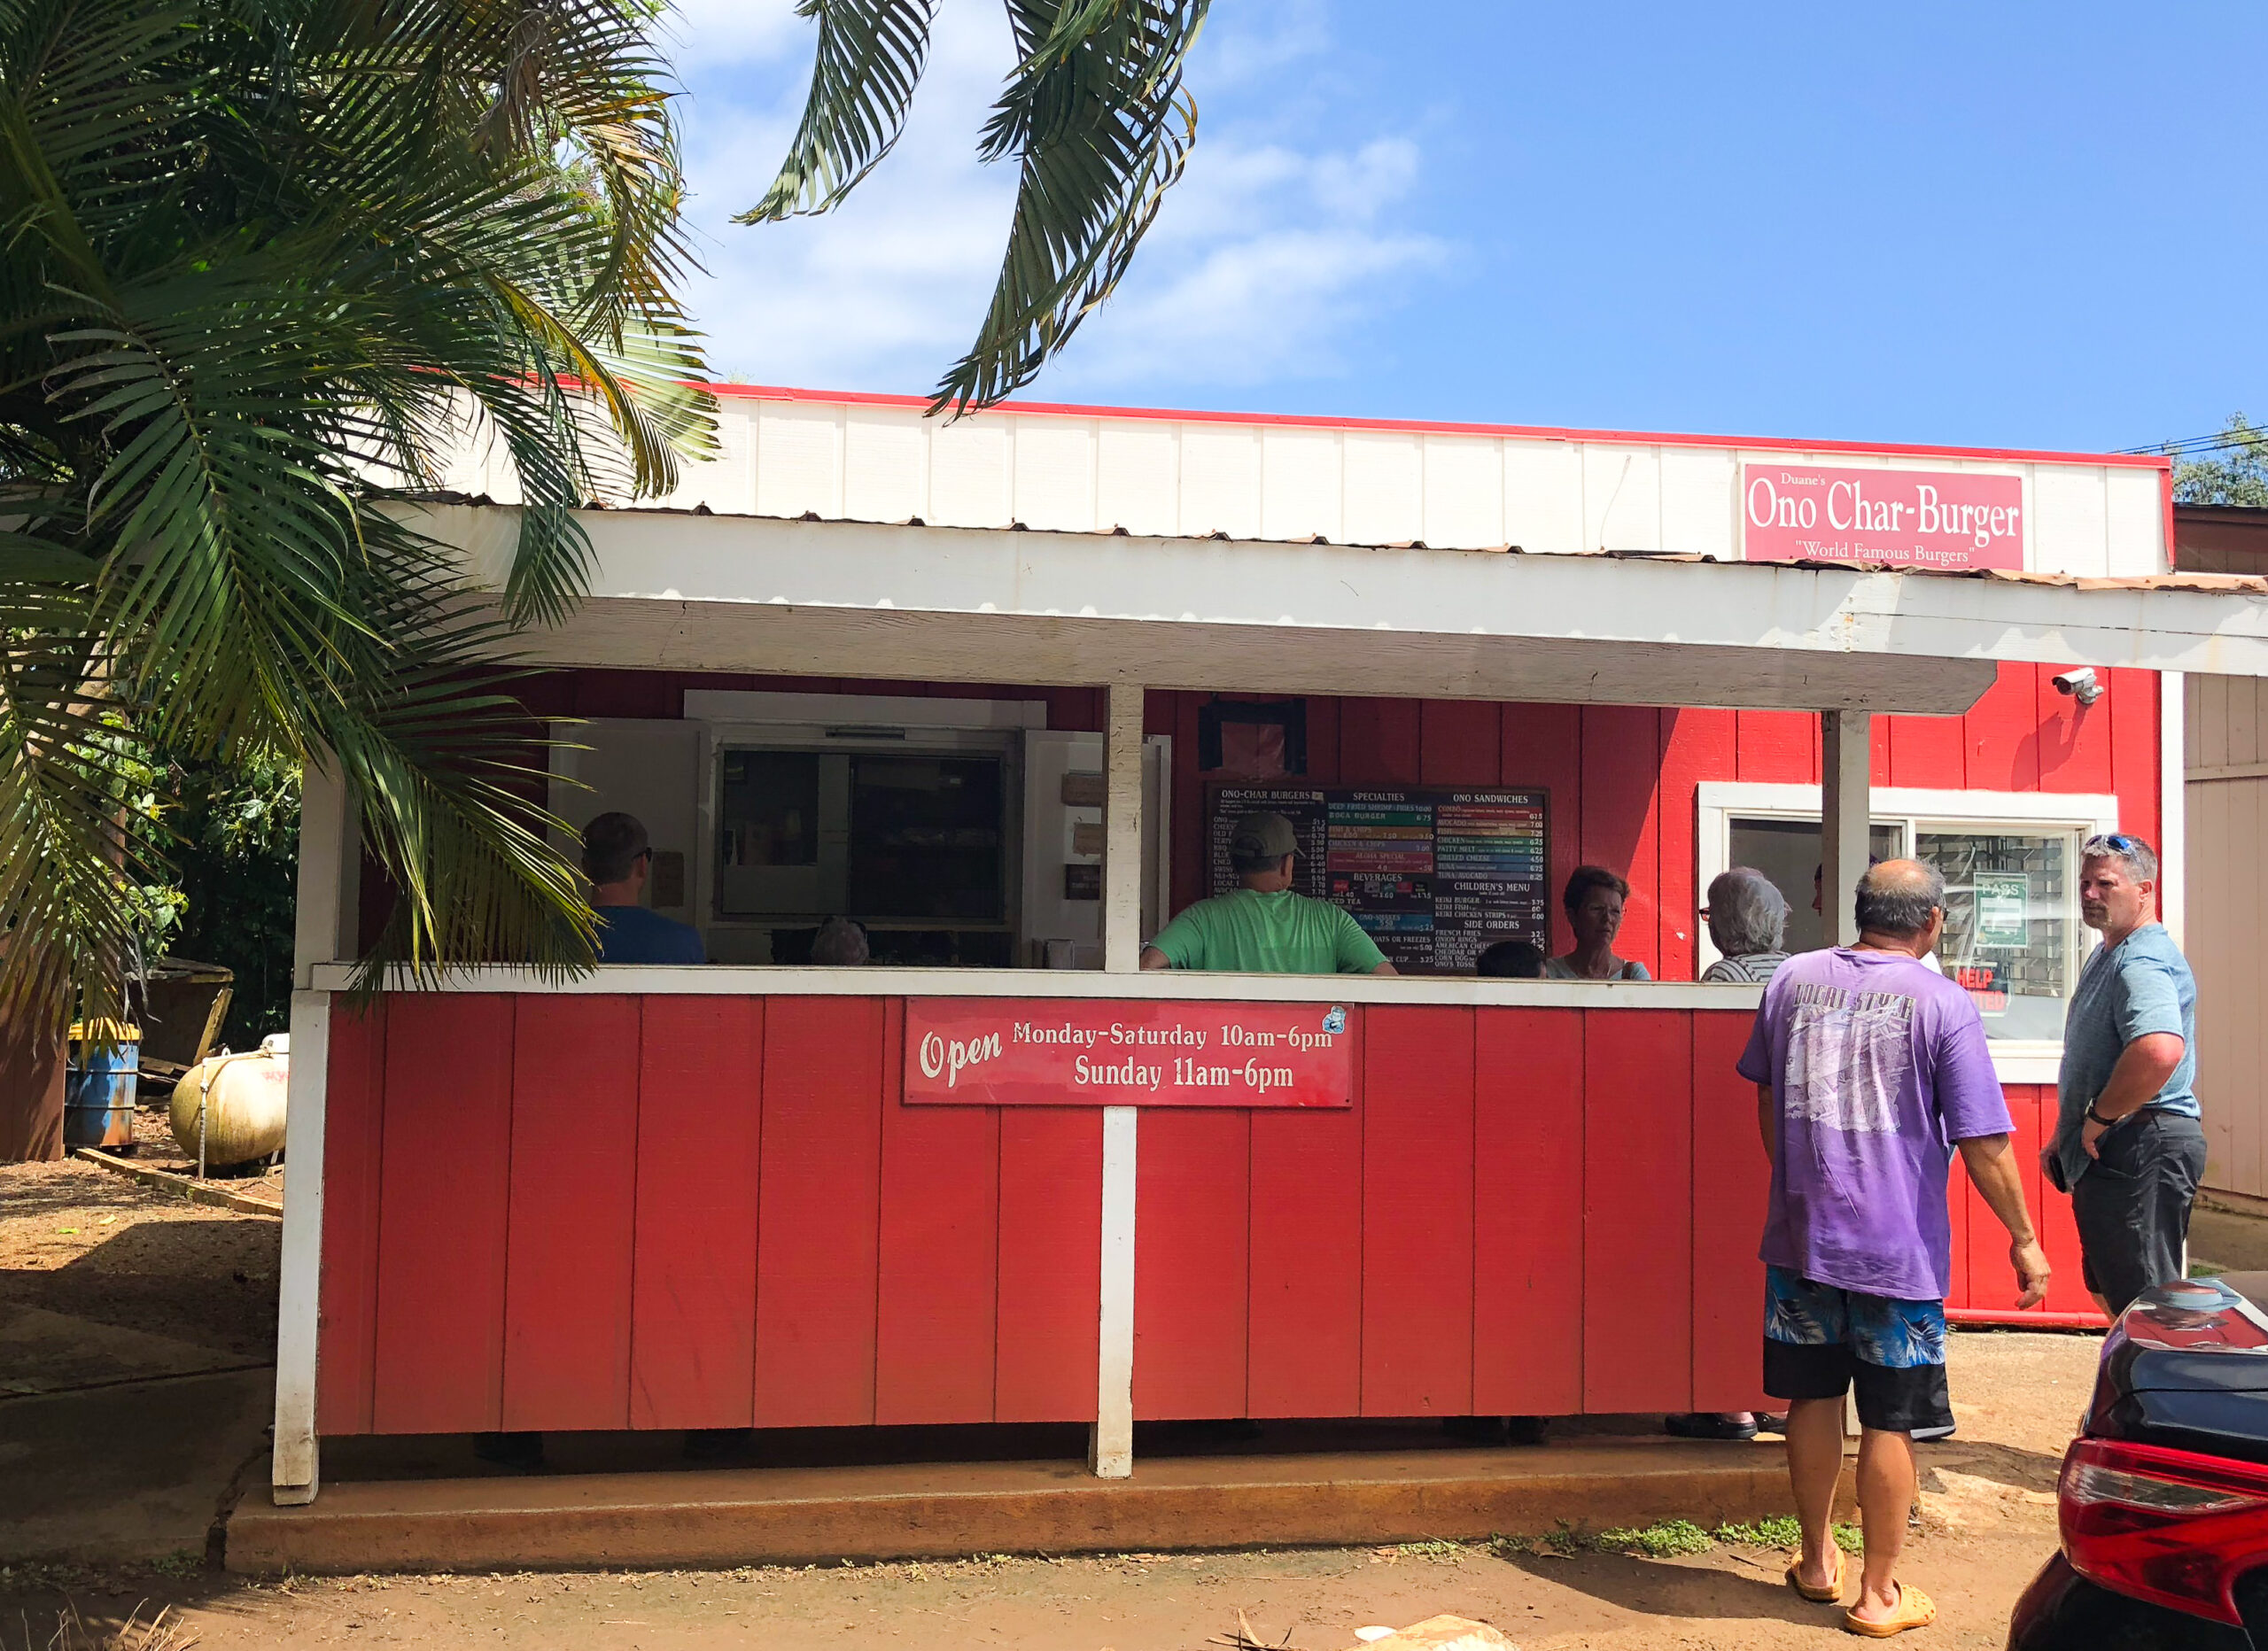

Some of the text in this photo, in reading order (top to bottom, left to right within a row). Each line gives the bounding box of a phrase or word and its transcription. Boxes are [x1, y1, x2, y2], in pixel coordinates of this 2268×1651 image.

[1781, 472, 1826, 486] Duane's
[1747, 477, 2020, 548] Ono Char-Burger
[1795, 539, 1975, 567] "World Famous Burgers"
[1222, 789, 1310, 800] ONO-CHAR BURGERS
[1353, 792, 1405, 802] SPECIALTIES
[1453, 794, 1528, 804] ONO SANDWICHES
[1353, 872, 1402, 882] BEVERAGES
[1454, 882, 1531, 893] CHILDREN'S MENU
[1982, 883, 2019, 896] PASS
[1464, 919, 1520, 929] SIDE ORDERS
[1957, 967, 1993, 989] HELP
[1013, 1021, 1333, 1053] Monday-Saturday 10am-6pm
[919, 1029, 1003, 1089] Open
[1073, 1054, 1294, 1094] Sunday 11am-6pm
